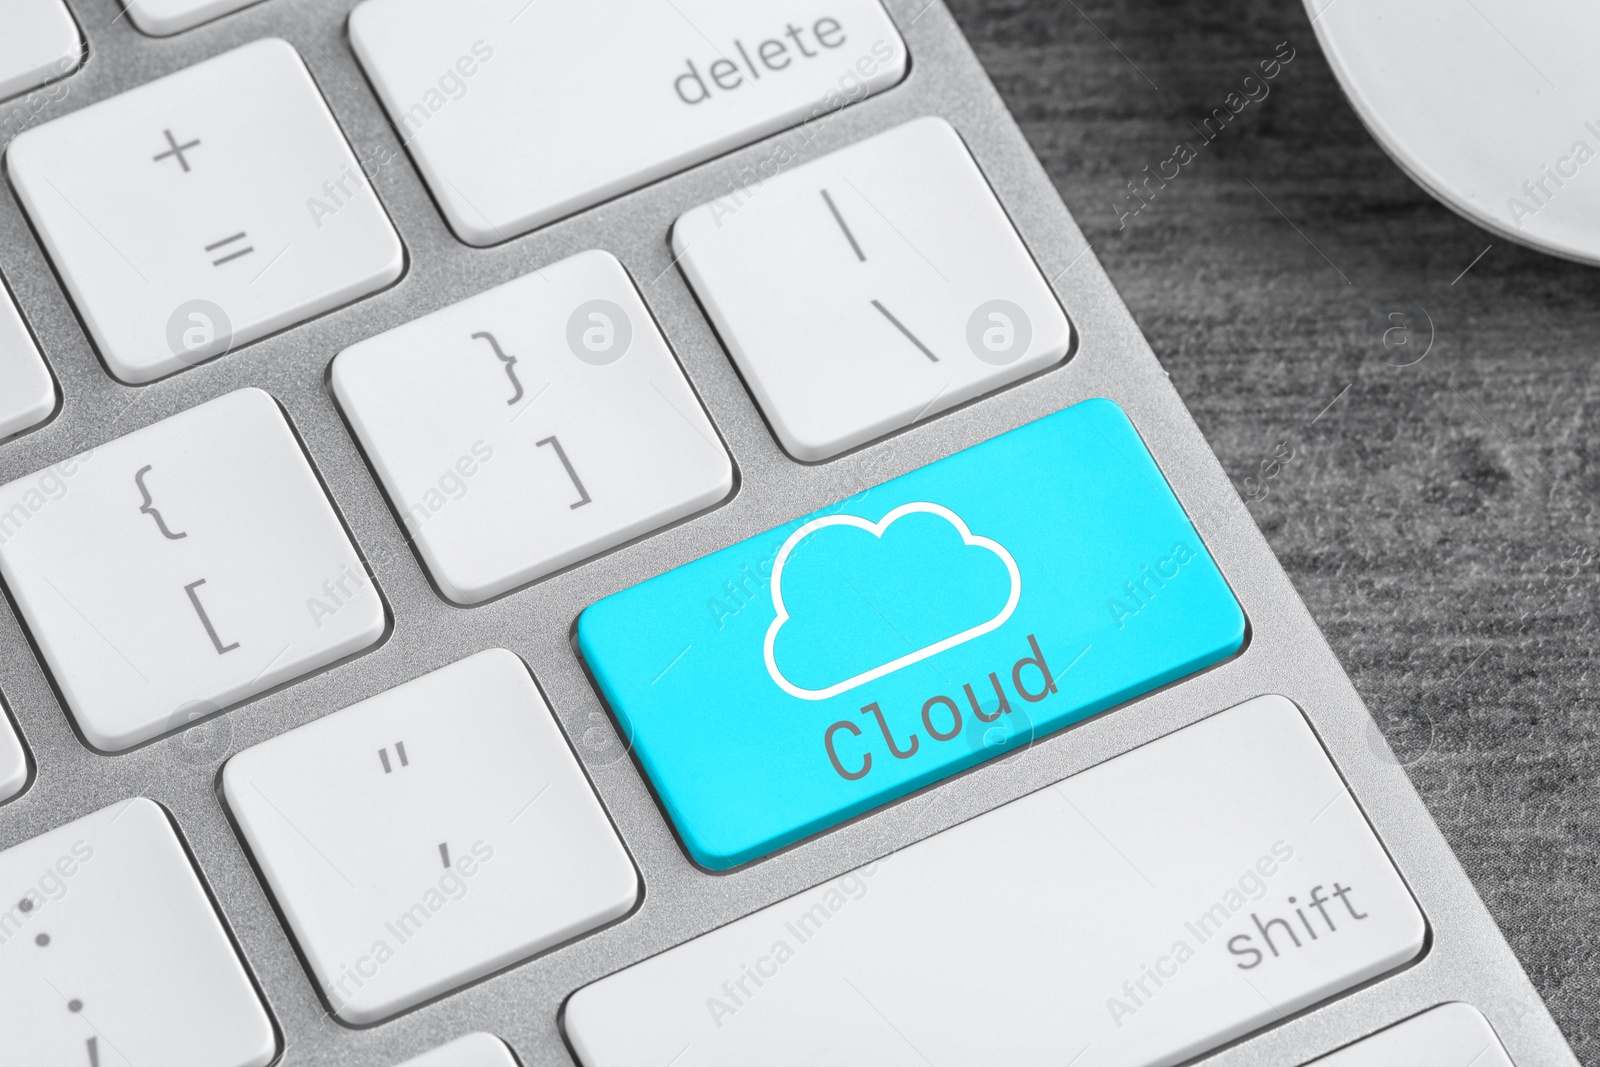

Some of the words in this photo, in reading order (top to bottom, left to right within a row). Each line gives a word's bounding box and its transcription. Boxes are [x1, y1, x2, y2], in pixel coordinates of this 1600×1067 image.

[673, 14, 848, 107] delete
[822, 632, 1060, 782] Cloud
[1226, 881, 1369, 970] shift
